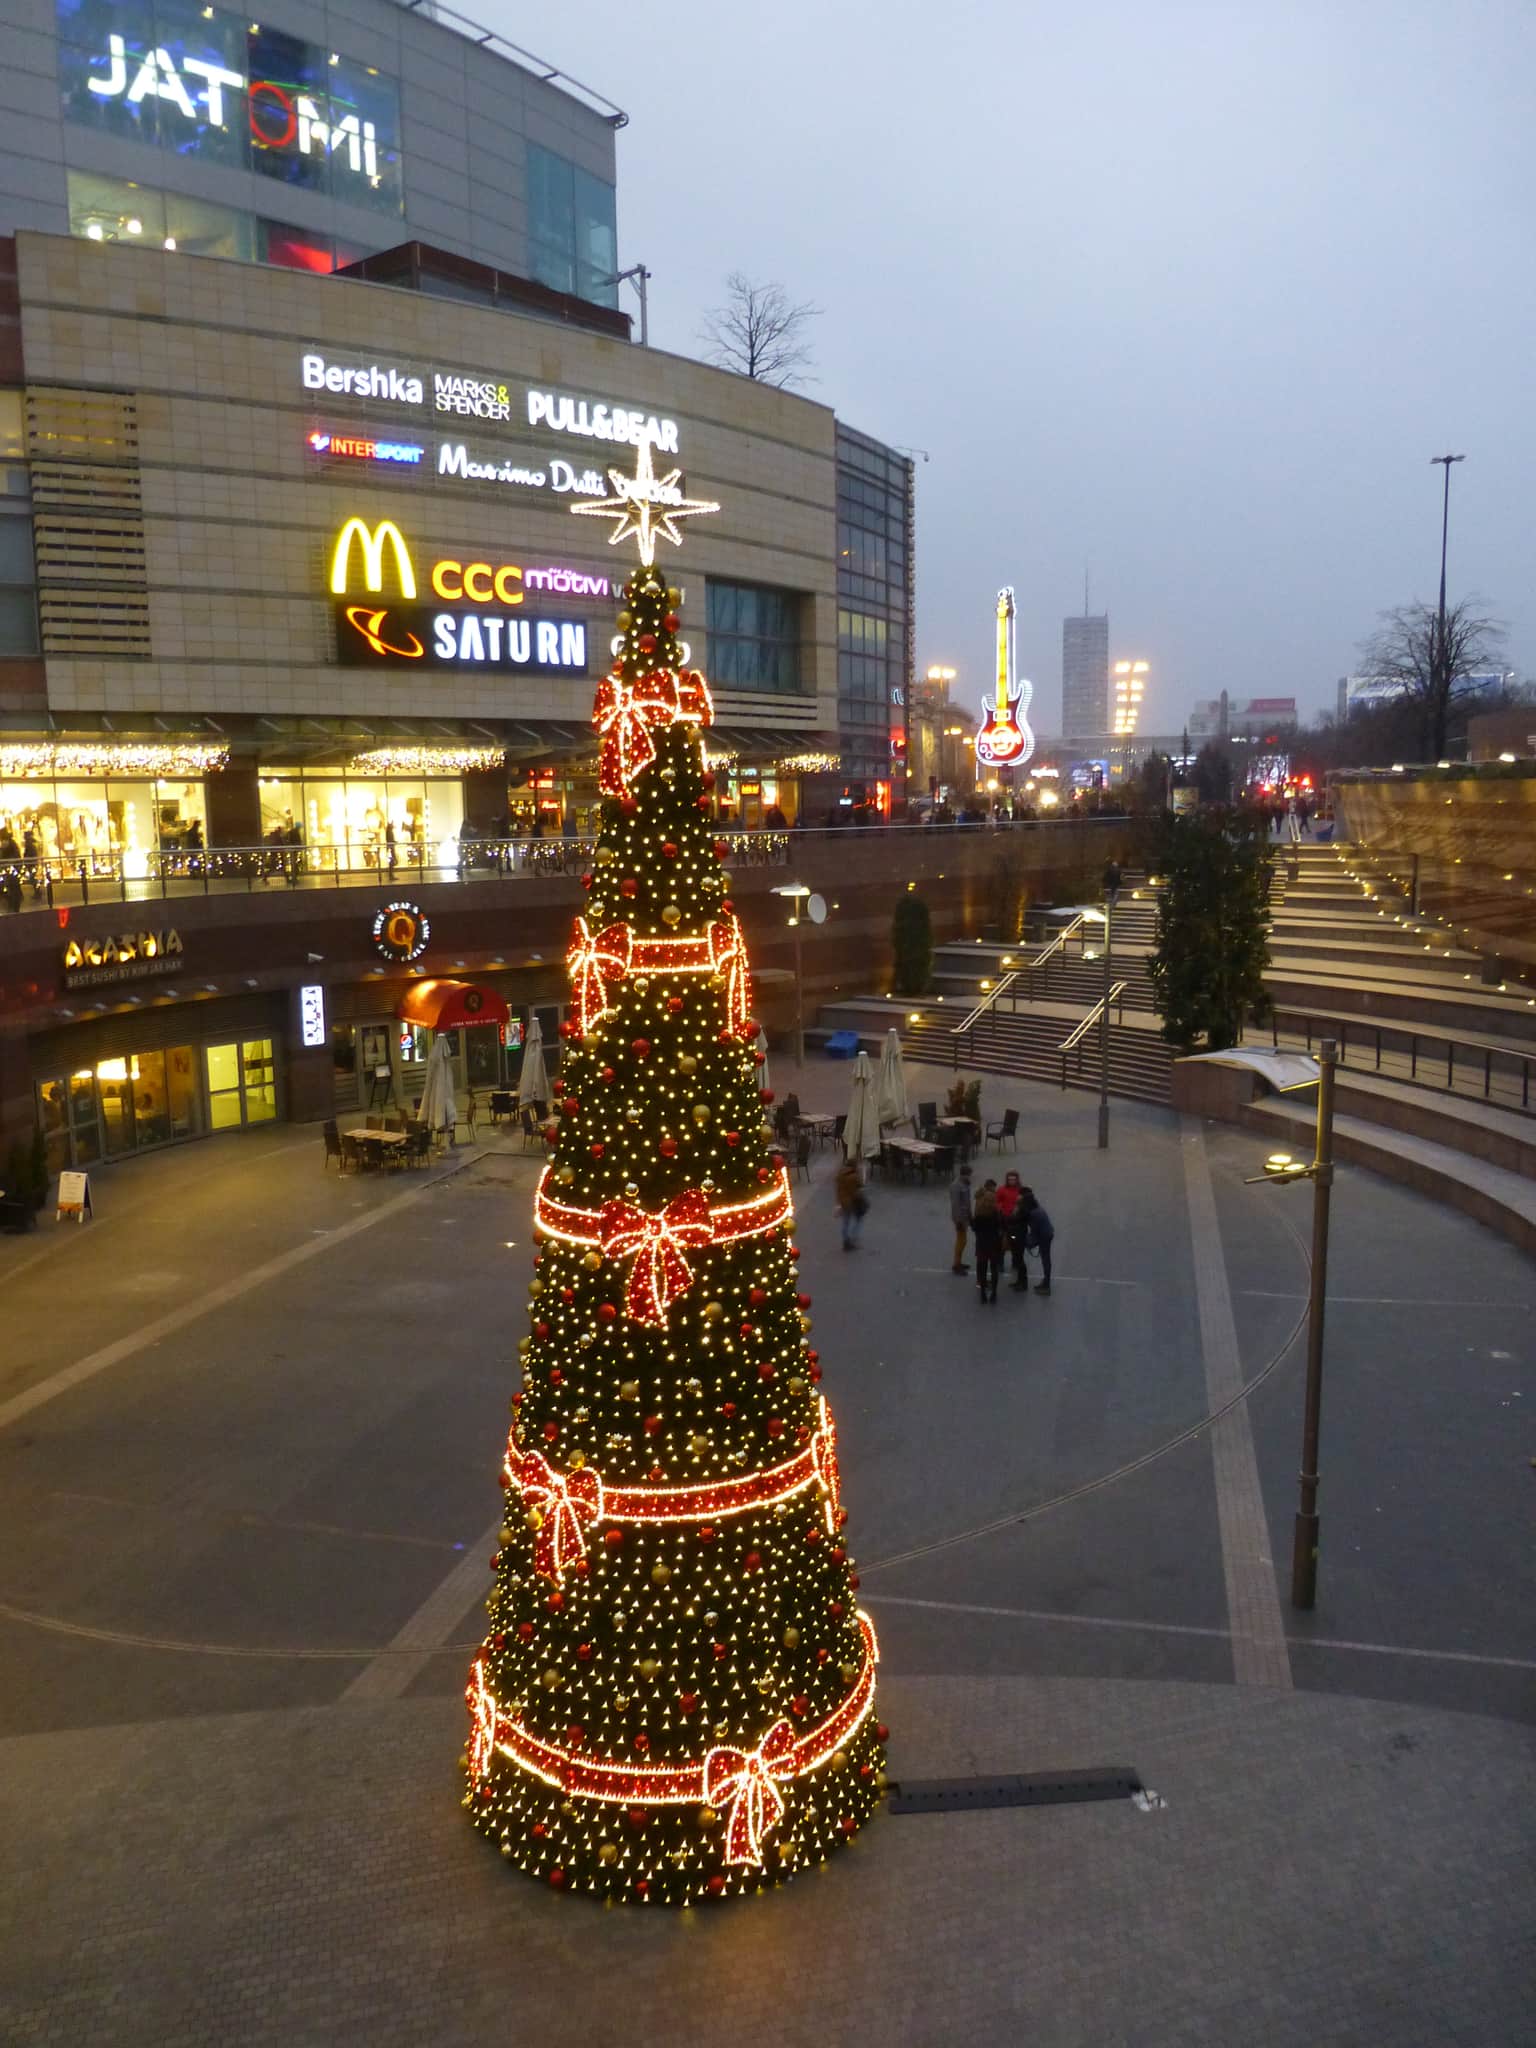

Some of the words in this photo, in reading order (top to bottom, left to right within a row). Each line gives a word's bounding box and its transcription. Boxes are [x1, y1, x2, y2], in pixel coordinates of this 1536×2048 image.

[87, 33, 377, 177] JATOMI
[302, 355, 424, 404] Bershka
[435, 392, 510, 422] SPENCER
[527, 390, 680, 455] PULL&BEAR
[330, 436, 424, 464] INTERSPORT
[438, 443, 546, 488] Massimo
[549, 459, 608, 497] Dutti
[431, 559, 525, 605] CCC
[433, 613, 587, 667] SATURN
[65, 927, 184, 969] AKASHIA
